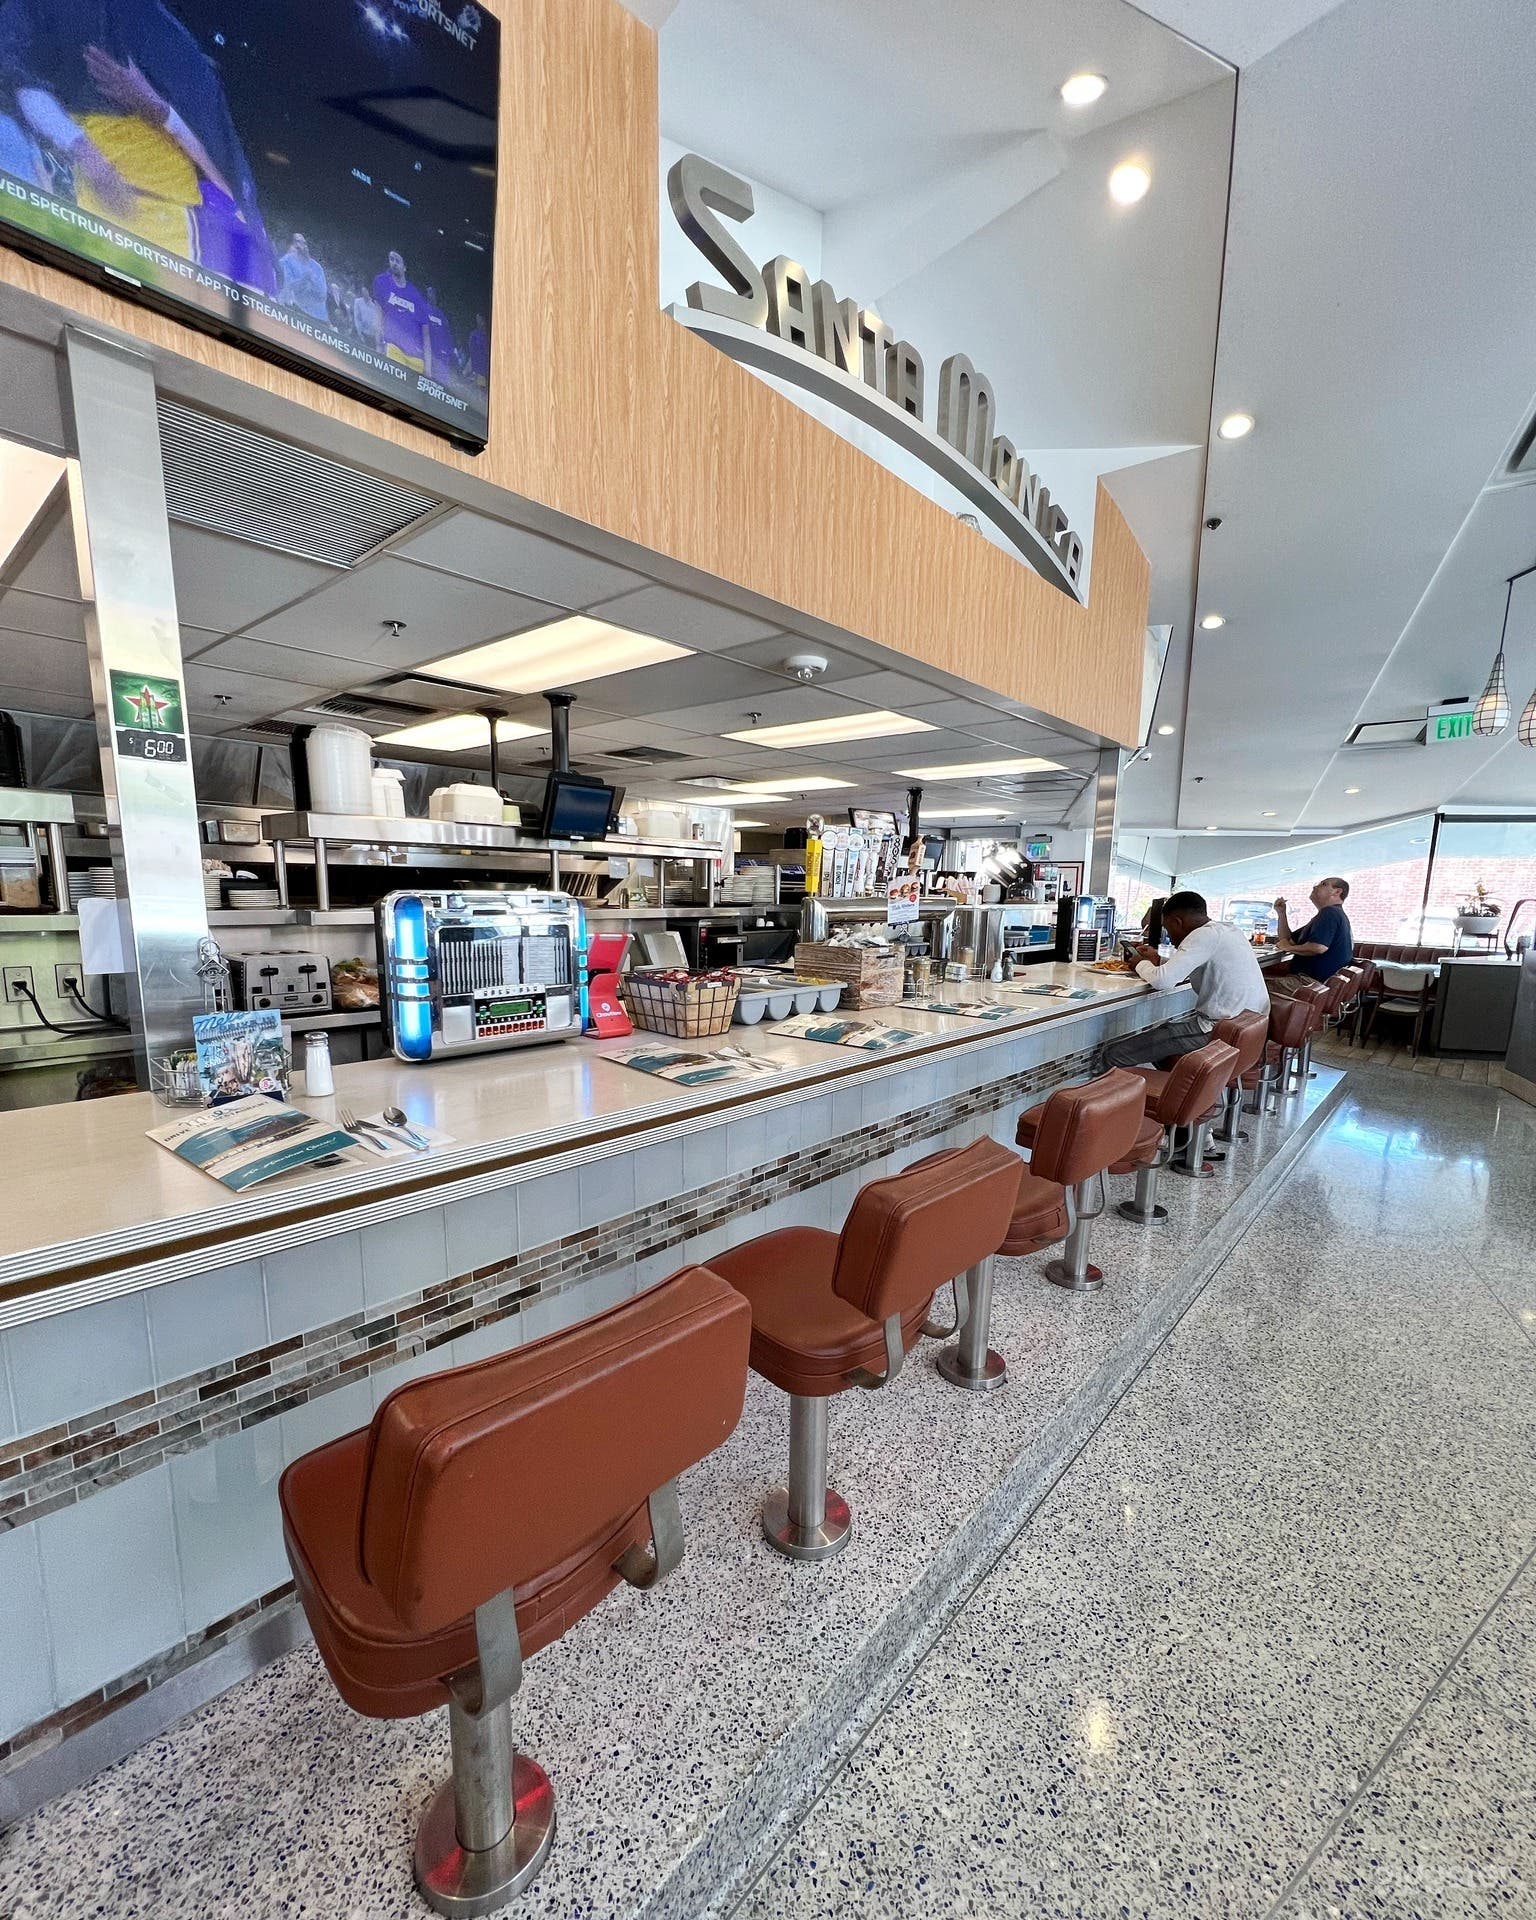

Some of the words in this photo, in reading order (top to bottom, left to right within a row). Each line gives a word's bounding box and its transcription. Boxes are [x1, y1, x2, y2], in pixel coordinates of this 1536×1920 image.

[30, 192, 114, 243] SPECTRUM
[115, 232, 194, 279] SPORTSNET
[196, 273, 222, 292] APP
[222, 284, 240, 301] TO
[242, 294, 289, 326] STREAM
[290, 318, 313, 337] LIVE
[314, 329, 350, 355] GAMES
[352, 348, 373, 365] AND
[373, 356, 408, 382] WATCH
[416, 380, 469, 412] SPORTSNET
[667, 153, 925, 423] SANTA
[937, 352, 1085, 586] MONICA
[1437, 714, 1473, 740] EXIT
